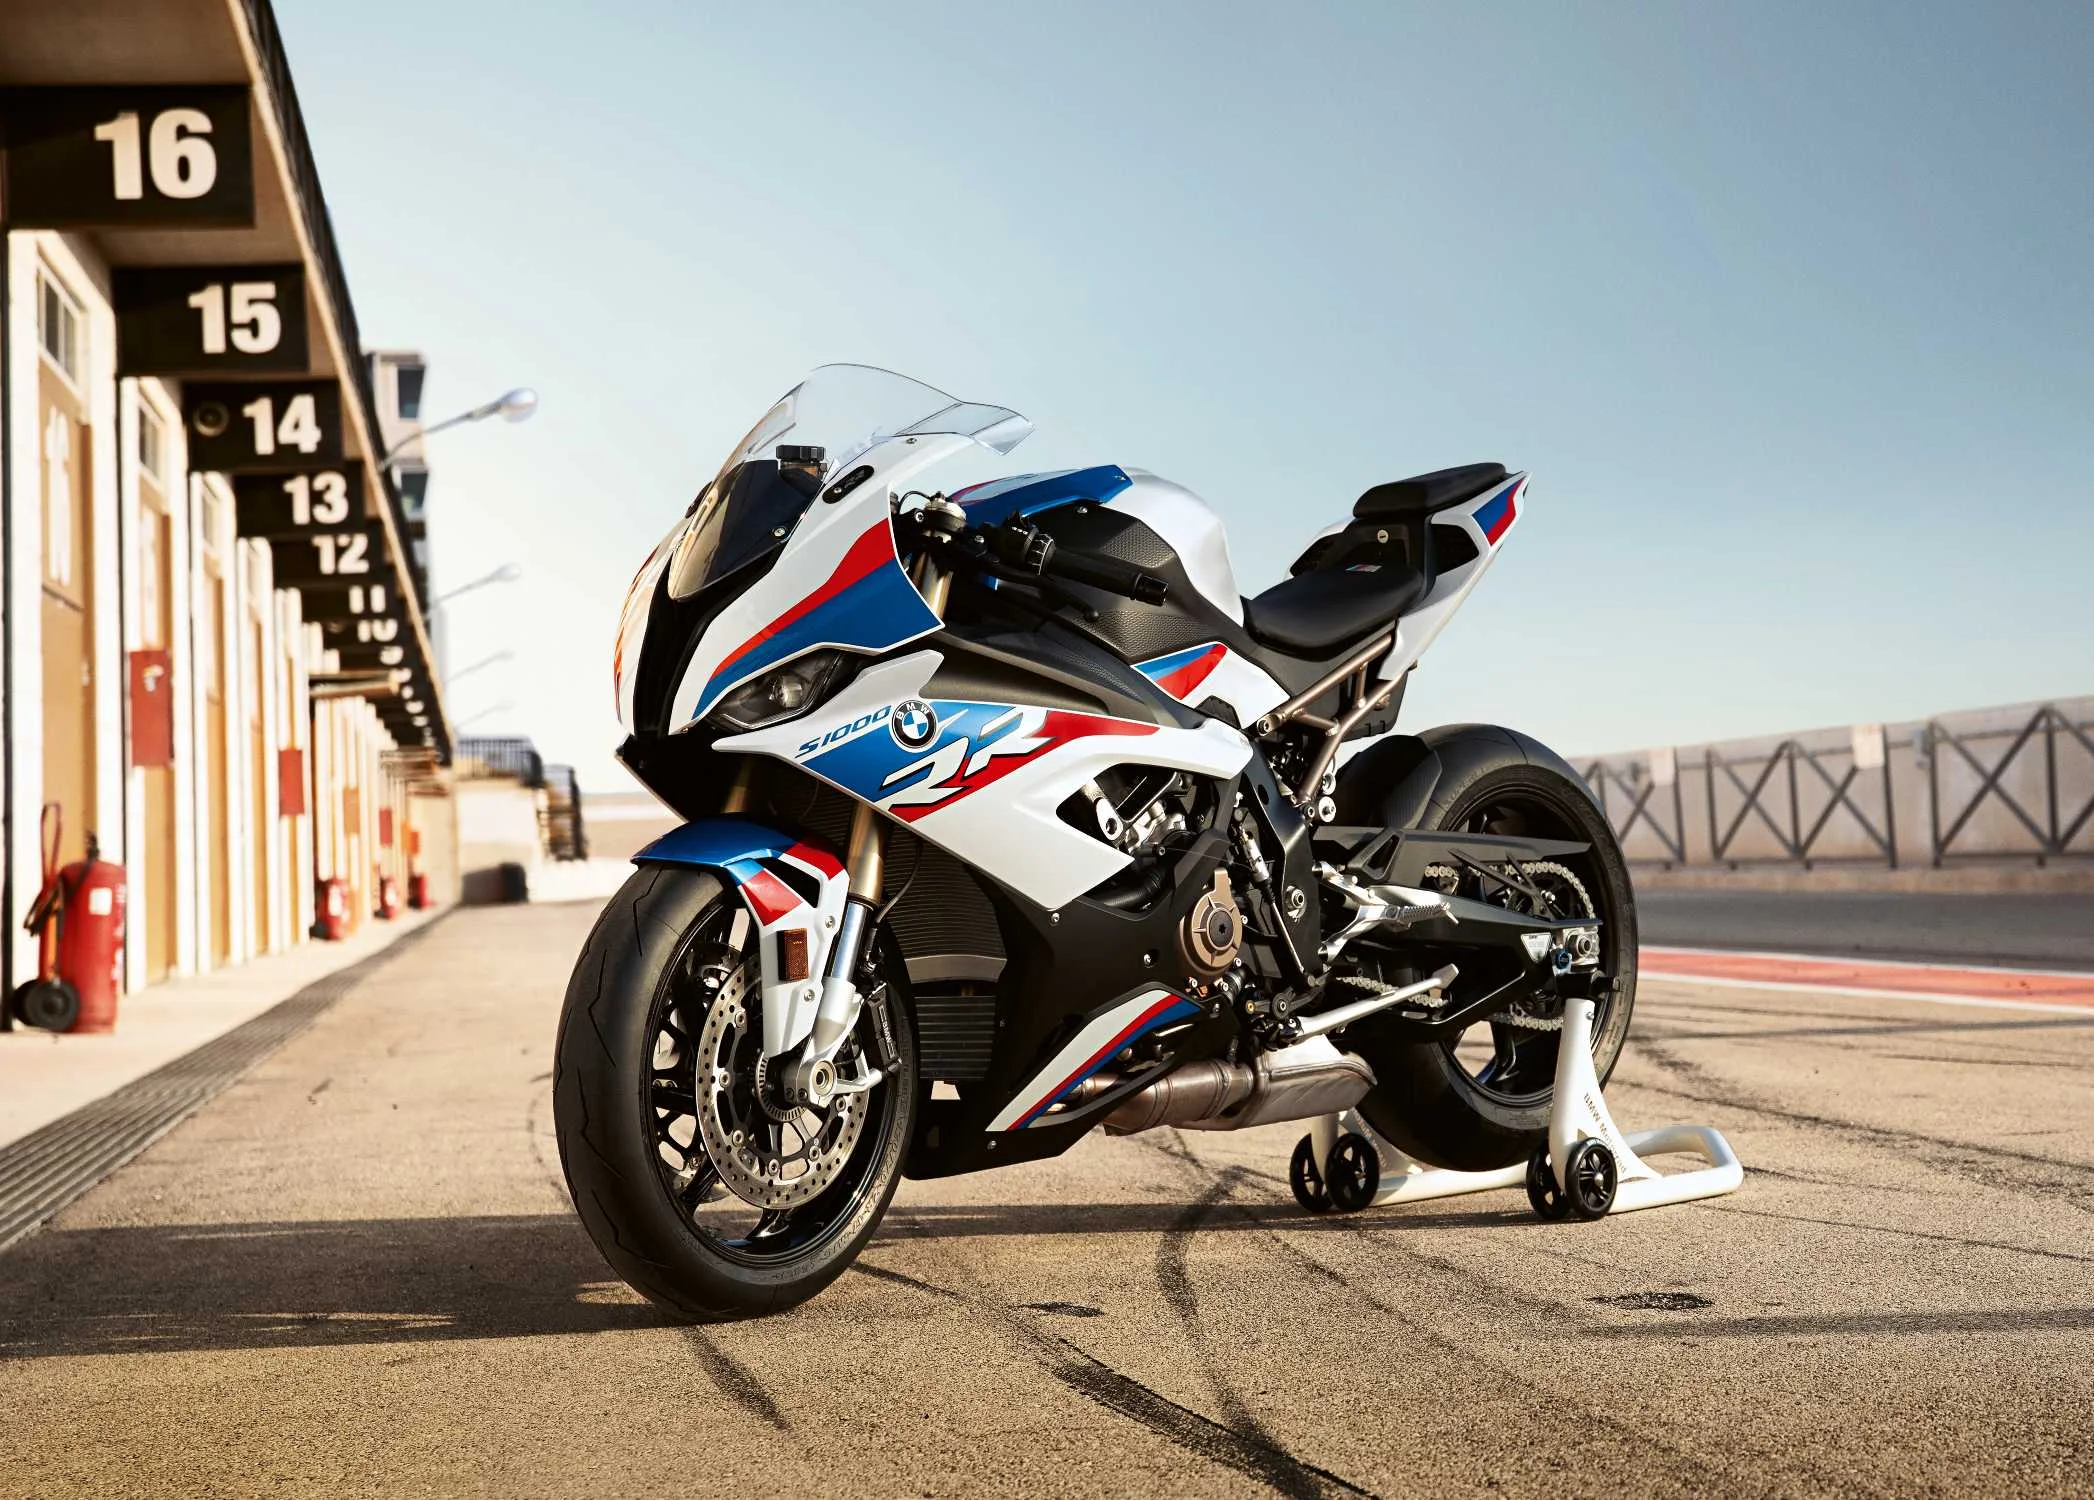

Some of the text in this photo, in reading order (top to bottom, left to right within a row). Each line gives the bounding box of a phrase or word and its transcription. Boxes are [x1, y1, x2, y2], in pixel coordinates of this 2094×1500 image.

[94, 108, 217, 200] 16
[188, 282, 281, 354] 15
[243, 394, 321, 455] 14
[283, 471, 349, 525] 13
[312, 533, 369, 575] 12
[795, 705, 892, 757] S1000
[896, 702, 930, 720] BMW
